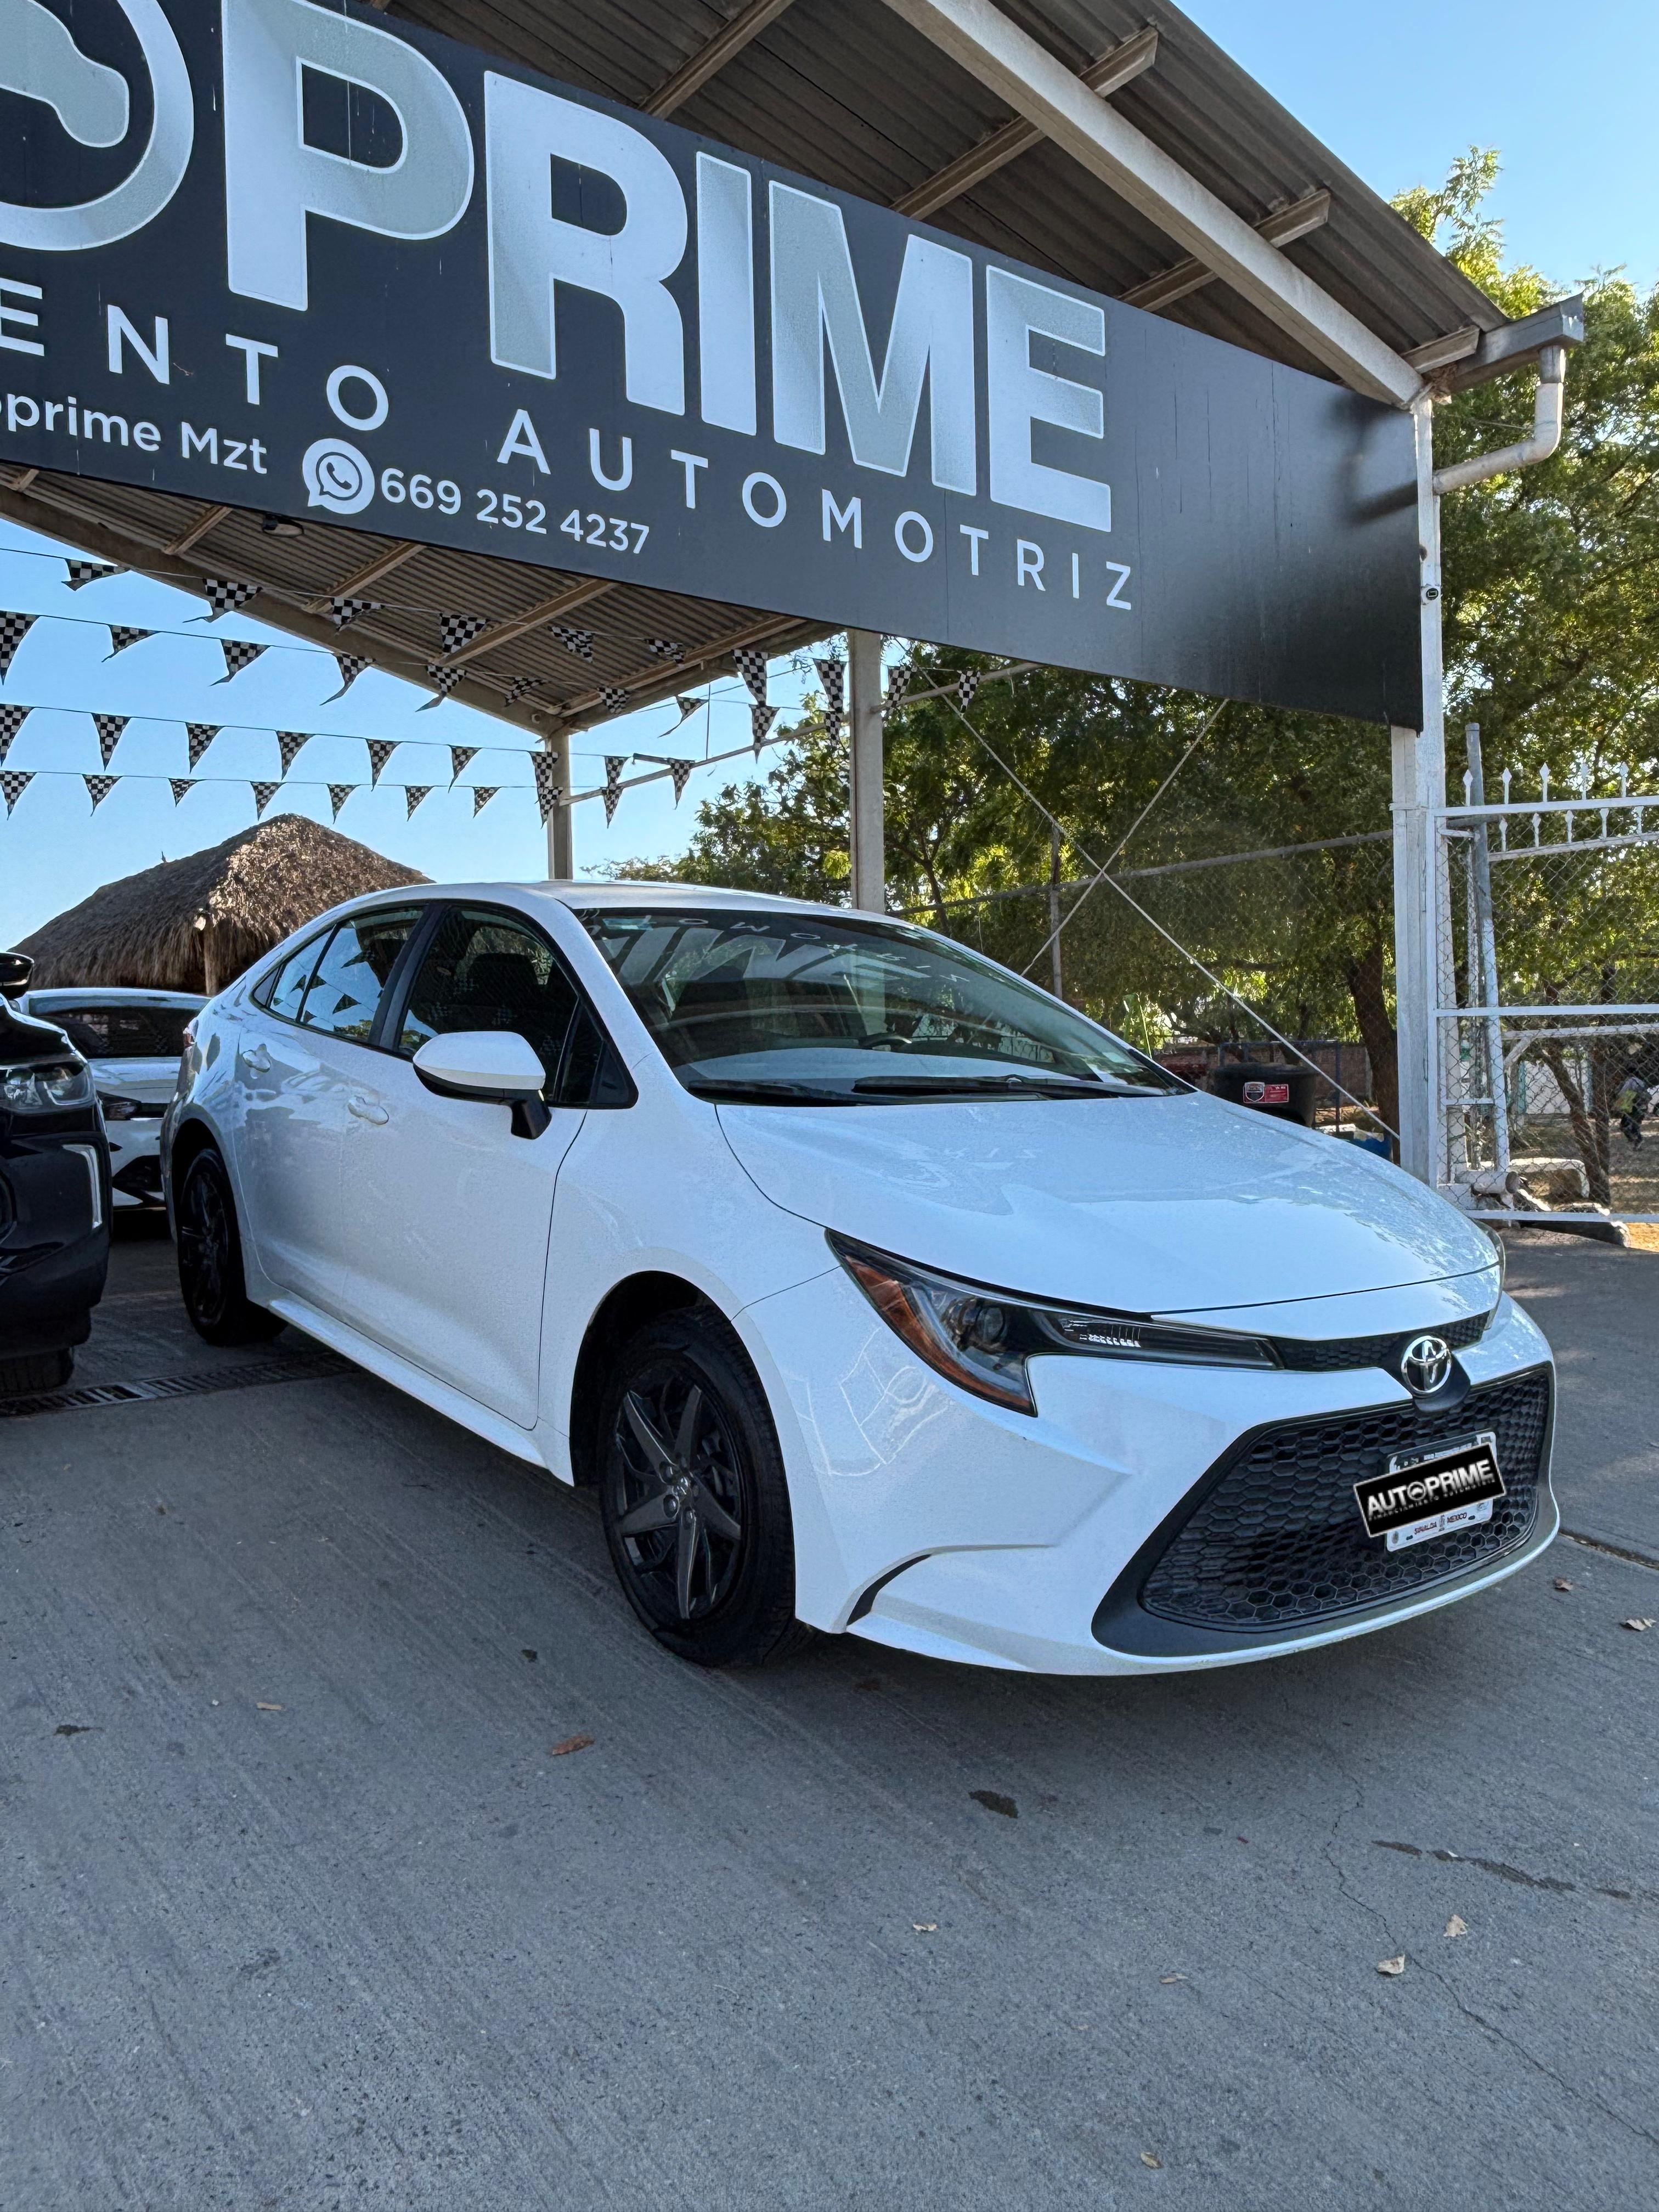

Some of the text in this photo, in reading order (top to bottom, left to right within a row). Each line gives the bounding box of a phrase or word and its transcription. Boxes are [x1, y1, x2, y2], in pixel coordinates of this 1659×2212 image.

[0, 393, 267, 474] prime Mzt
[0, 277, 1132, 611] ENTO AUTOMOTRIZ
[381, 467, 650, 554] 669 252 4237
